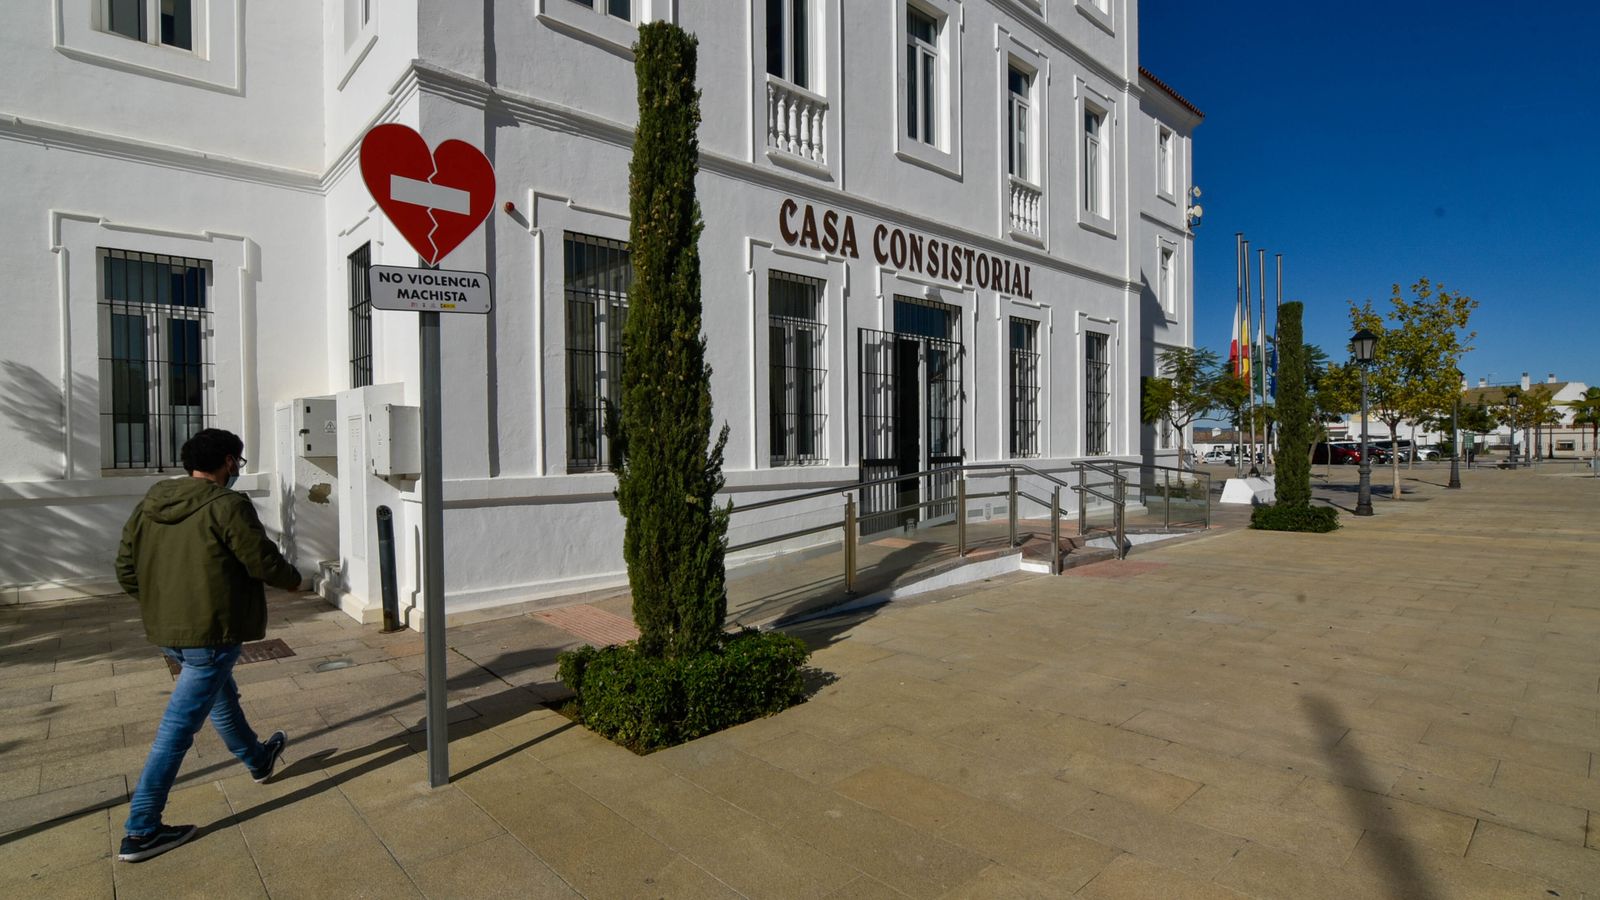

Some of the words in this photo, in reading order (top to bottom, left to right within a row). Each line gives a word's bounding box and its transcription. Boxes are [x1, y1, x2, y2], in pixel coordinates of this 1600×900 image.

[779, 198, 859, 259] CASA
[873, 224, 1032, 300] CONSISTORIAL
[379, 271, 403, 284] NO
[408, 273, 480, 289] VIOLENCIA
[397, 288, 467, 302] MACHISTA
